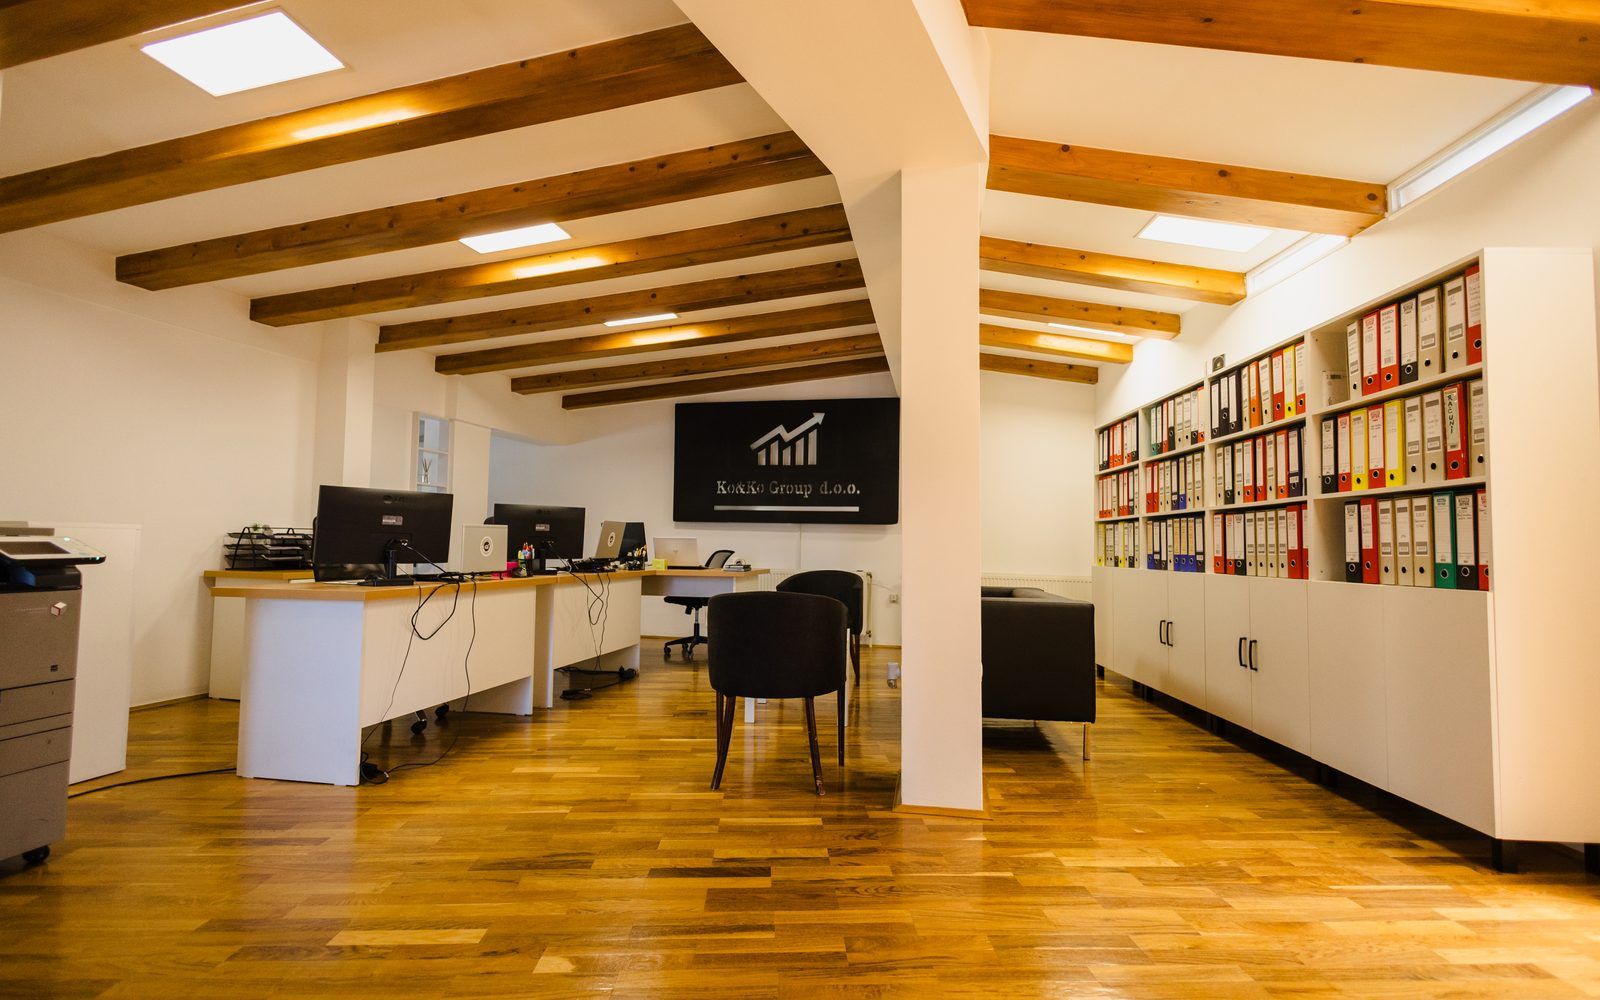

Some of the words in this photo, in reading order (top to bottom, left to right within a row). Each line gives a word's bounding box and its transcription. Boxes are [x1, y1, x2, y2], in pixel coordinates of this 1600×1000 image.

[716, 481, 765, 495] Ko&Ko
[769, 481, 813, 498] Group
[820, 481, 861, 495] d.o.o.
